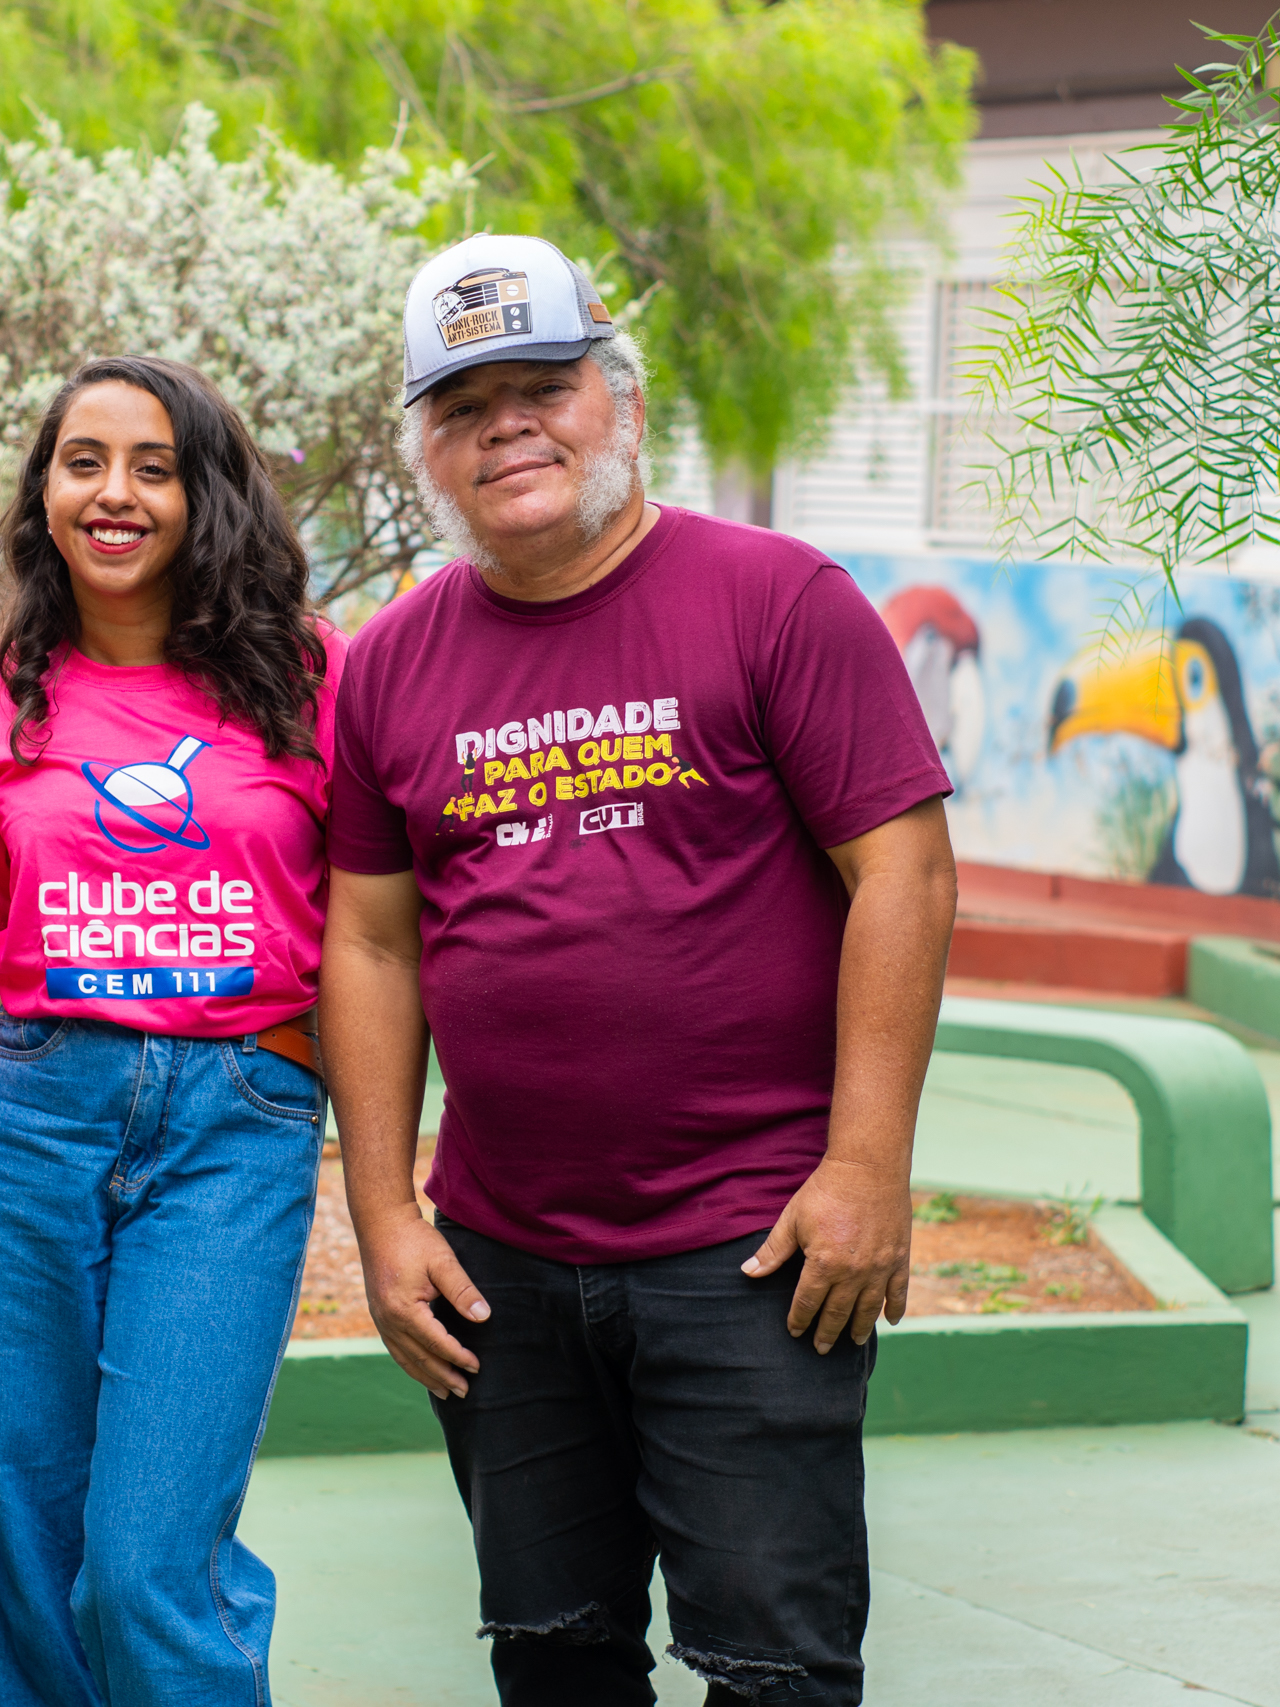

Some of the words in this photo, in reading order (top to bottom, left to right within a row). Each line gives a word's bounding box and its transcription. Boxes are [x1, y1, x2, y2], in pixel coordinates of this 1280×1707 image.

[448, 321, 501, 344] ANTI-SISTEMA
[455, 697, 680, 764] DIGNIDADE
[484, 746, 571, 786] PARA
[577, 733, 673, 767] QUEM
[457, 788, 518, 822] FAZ
[528, 781, 548, 807] O
[555, 762, 673, 801] ESTADO
[581, 804, 636, 833] CUT
[637, 802, 645, 826] BRASIL
[38, 871, 177, 915] clube
[188, 870, 253, 915] de
[41, 919, 255, 958] ciências
[78, 973, 153, 995] CEM
[172, 972, 216, 993] 111
